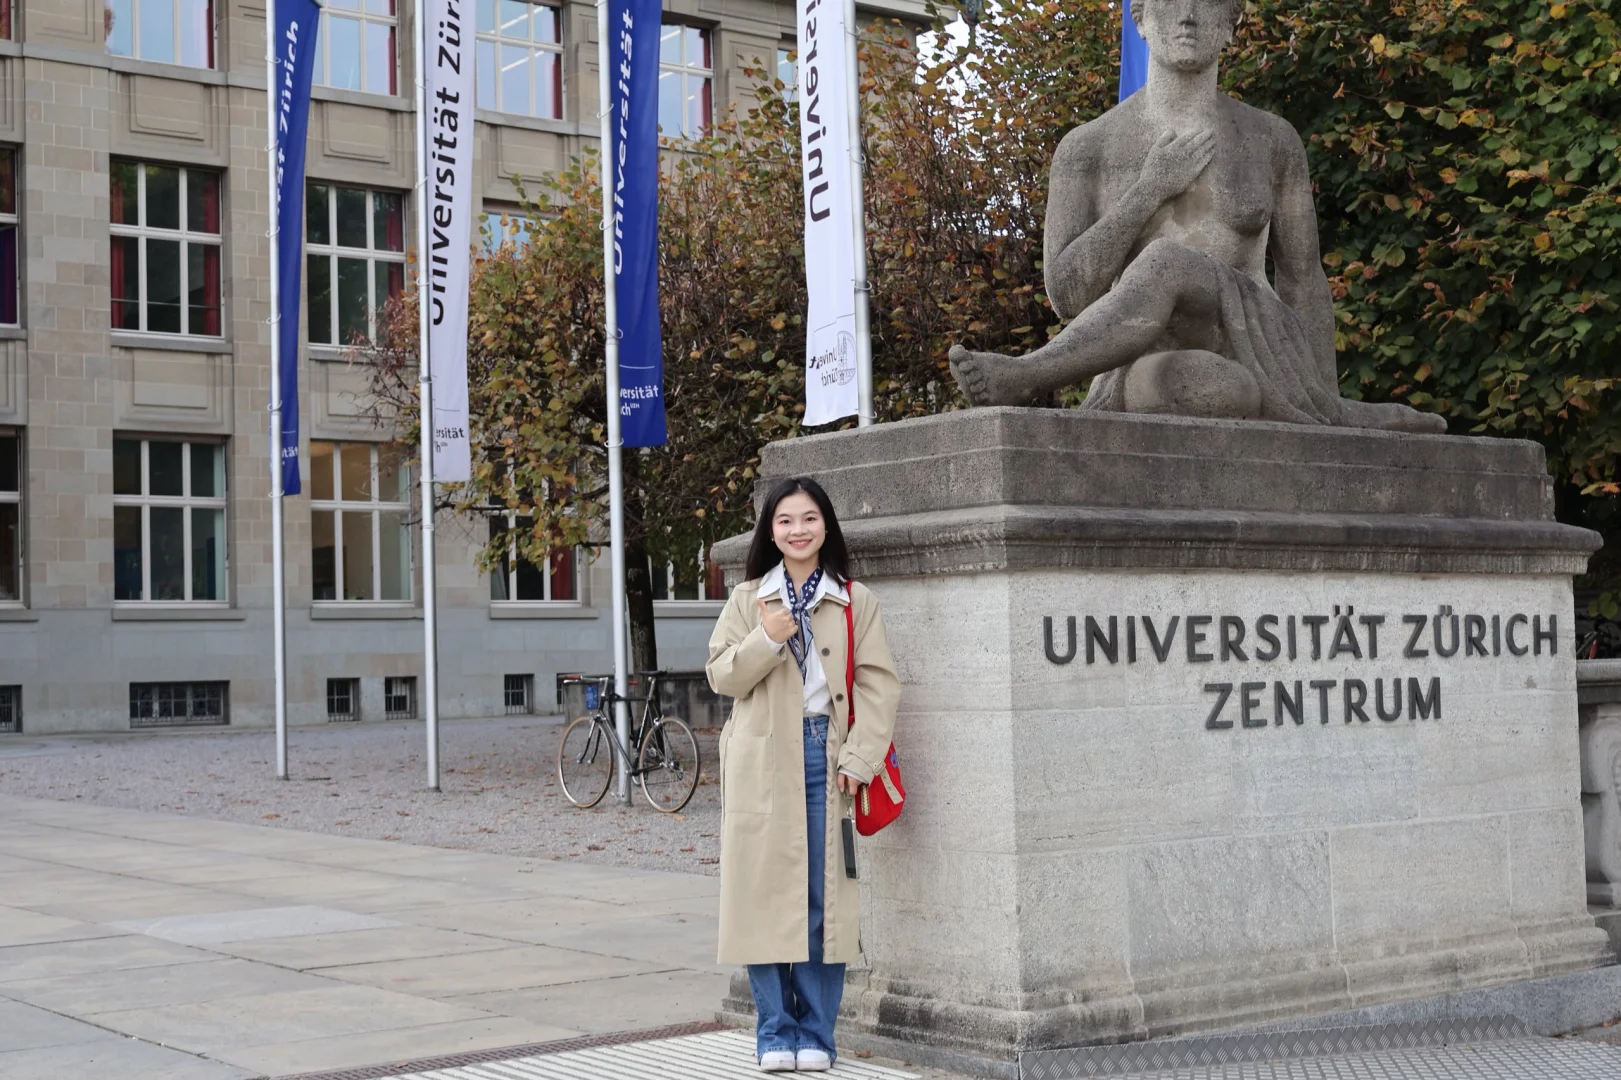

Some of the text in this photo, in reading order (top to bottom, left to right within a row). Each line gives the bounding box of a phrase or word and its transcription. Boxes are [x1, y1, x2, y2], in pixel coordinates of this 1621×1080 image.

[438, 0, 460, 75] Zür
[614, 8, 634, 275] Universität
[1043, 604, 1558, 664] UNIVERSITÄT ZÜRICH
[1203, 676, 1442, 730] ZENTRUM
